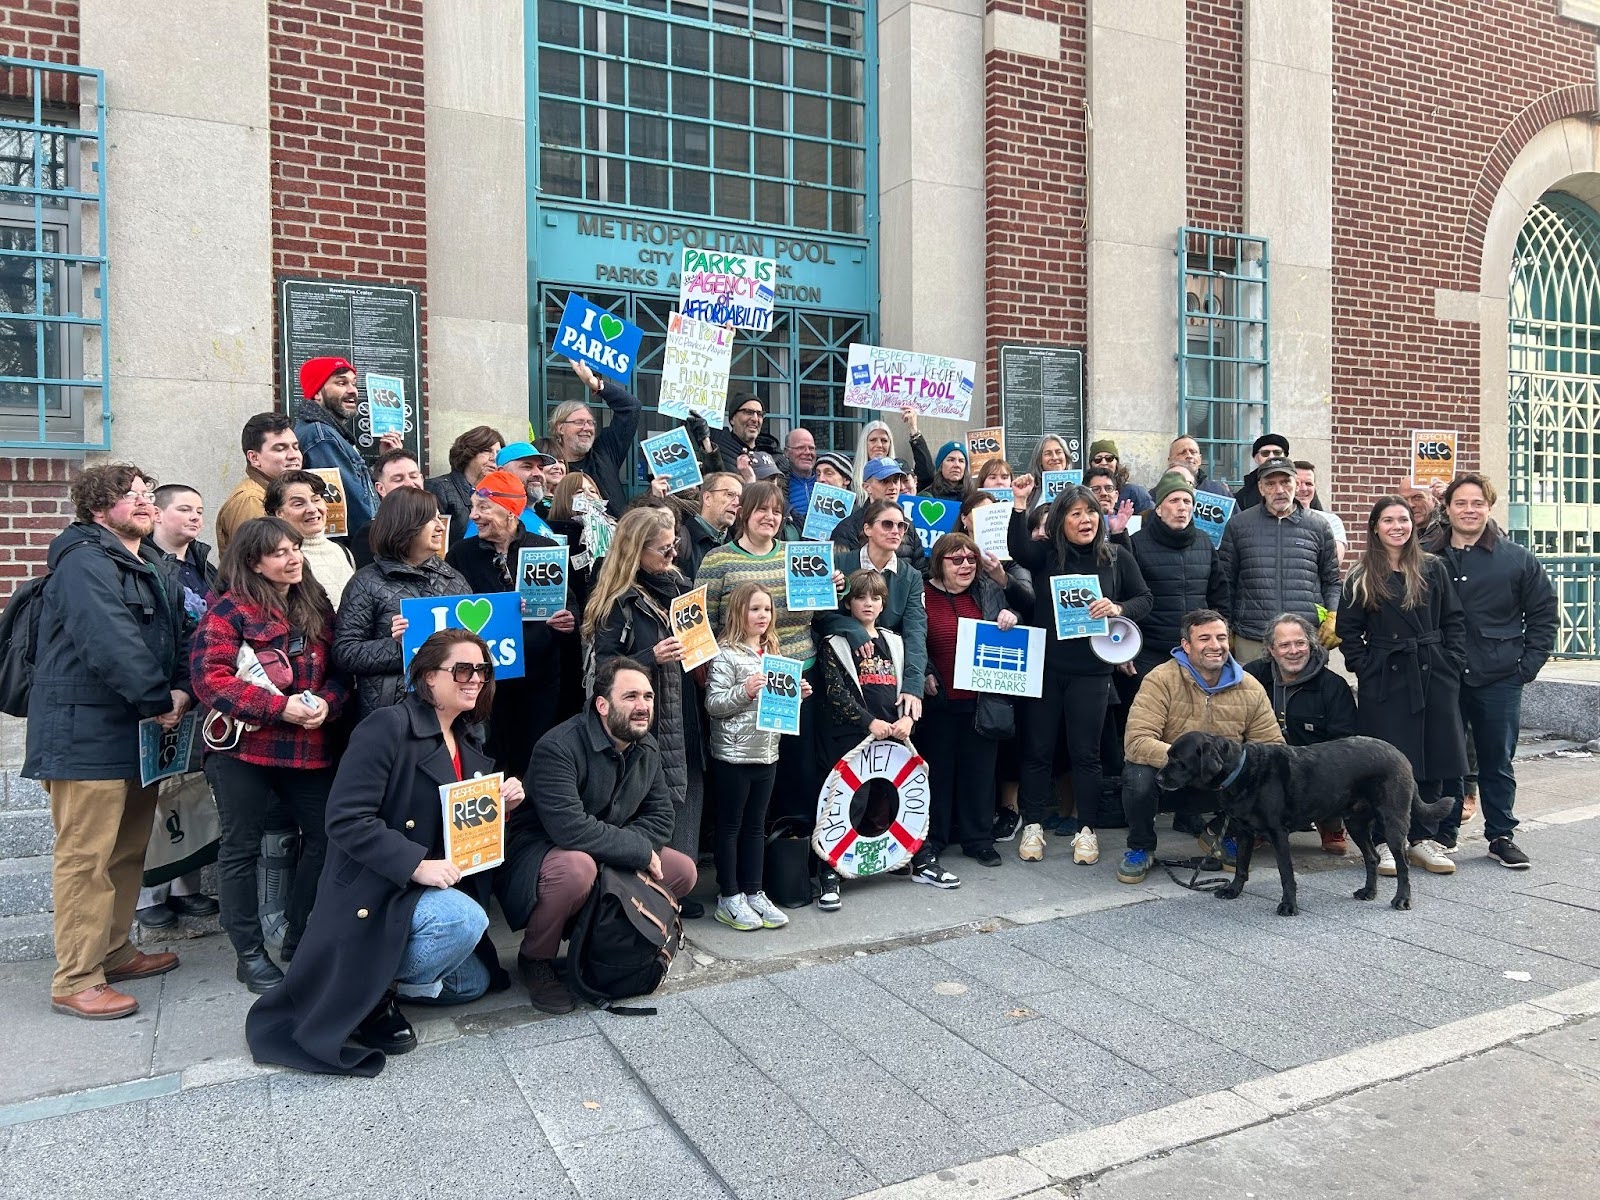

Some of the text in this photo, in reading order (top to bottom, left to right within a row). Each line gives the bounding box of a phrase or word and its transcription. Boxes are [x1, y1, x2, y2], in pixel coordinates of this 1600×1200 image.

[577, 213, 835, 264] METROPOLITAN POOL
[638, 249, 793, 279] CITY RK
[683, 249, 773, 282] PARKS IS
[596, 264, 658, 287] PARKS
[688, 271, 760, 298] AGENCY
[716, 291, 734, 307] of
[580, 308, 597, 331] I
[681, 298, 773, 330] AFFORDABILITY
[669, 314, 732, 348] MET POOL!
[561, 325, 630, 374] PARKS
[667, 346, 713, 368] FIX IT
[869, 347, 956, 369] RESPECT THE REC
[678, 366, 728, 389] FUND IT
[873, 359, 907, 376] FUND
[371, 387, 399, 404] REC
[661, 379, 726, 410] RE-OPEN IT
[870, 374, 916, 395] MET
[919, 378, 955, 400] POOL
[651, 442, 683, 464] REC
[970, 437, 997, 451] REC
[1417, 441, 1449, 456] REC
[817, 486, 840, 498] RESPECT
[813, 494, 846, 512] REC
[901, 501, 915, 521] I
[1193, 502, 1223, 519] REC
[524, 551, 554, 561] RESPECT
[790, 545, 819, 554] RESPECT
[523, 561, 562, 580] REC
[790, 554, 824, 572] REC
[1056, 579, 1083, 588] RESPECT
[1058, 587, 1094, 604] REC
[430, 606, 449, 633] I
[675, 602, 701, 626] REC
[766, 659, 790, 671] RESPECT
[971, 668, 1027, 682] NEW YORKERS
[765, 669, 795, 691] REC
[971, 676, 1026, 693] FOR PARKS
[452, 779, 498, 799] RESPECT THE
[860, 743, 899, 776] MET
[901, 773, 927, 823] POOL
[452, 794, 493, 823] REC
[855, 836, 890, 855] RESPECT
[861, 849, 880, 864] THE
